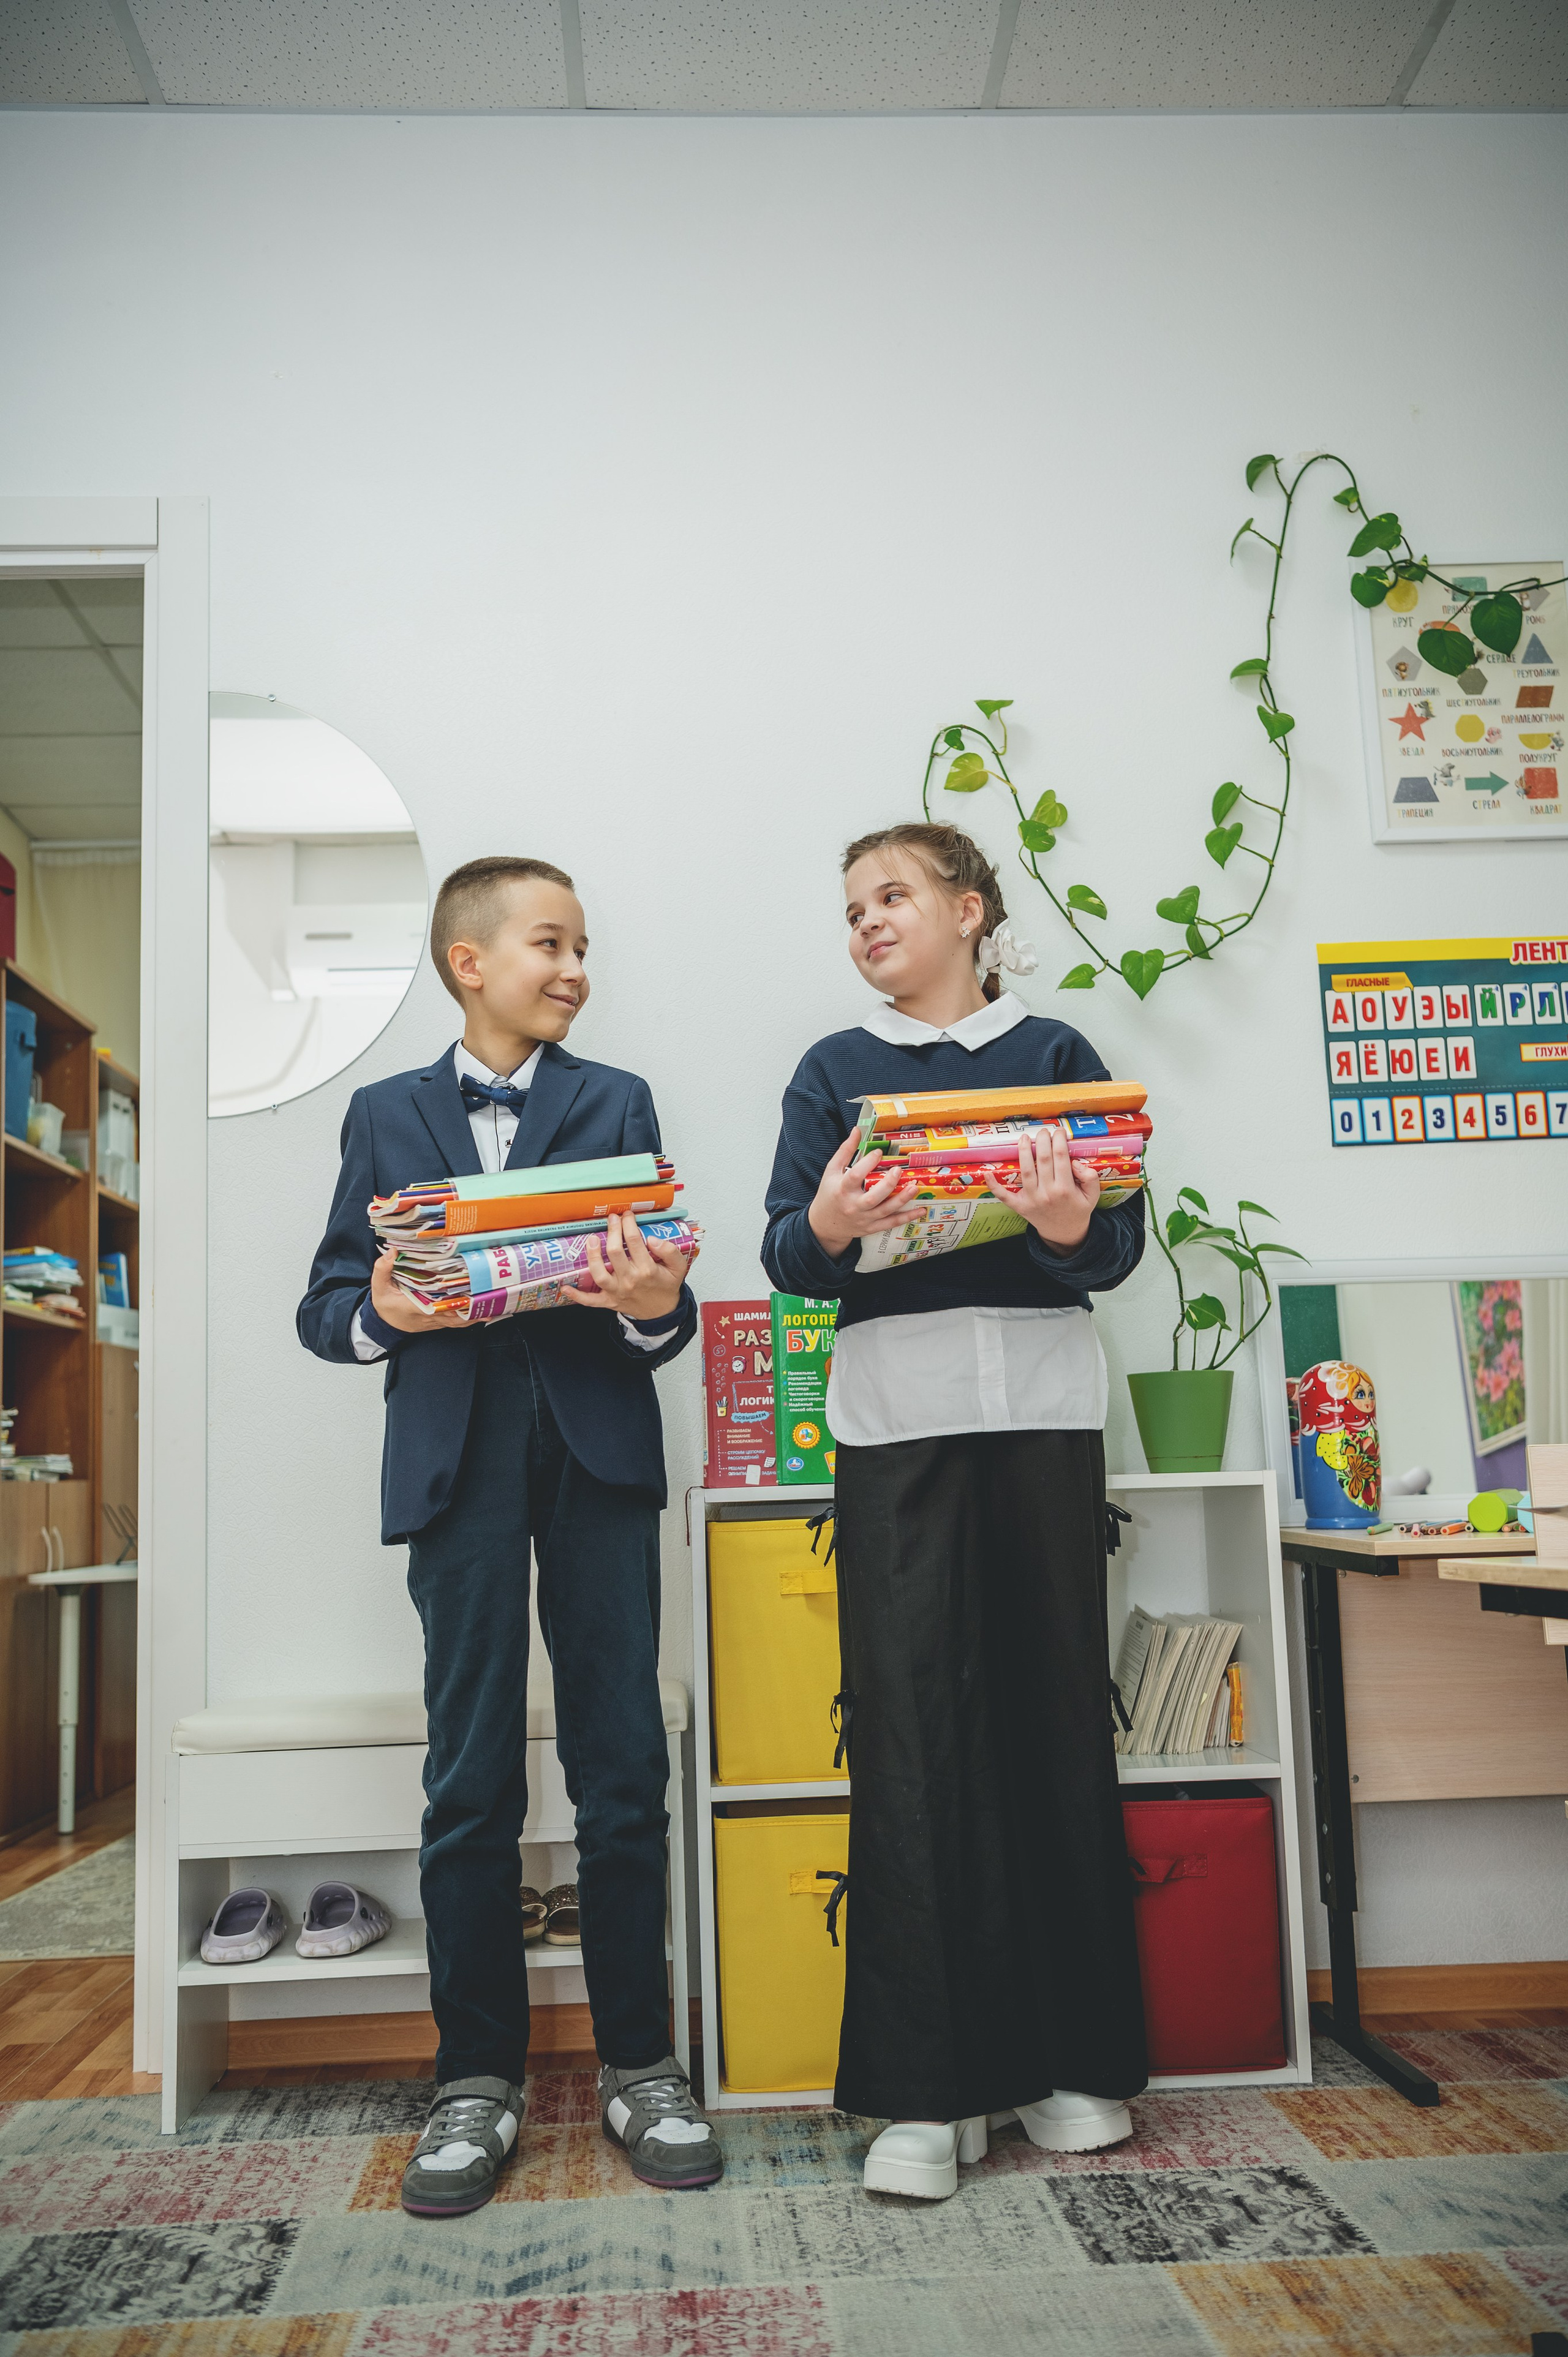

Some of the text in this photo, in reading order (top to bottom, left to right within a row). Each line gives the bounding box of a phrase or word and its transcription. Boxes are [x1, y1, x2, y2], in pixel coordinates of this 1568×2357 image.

[1392, 617, 1414, 628] КРУГ
[1526, 615, 1546, 625] РОМБ
[1513, 668, 1561, 678] ТРЕУГОЛЬНИК
[1382, 687, 1441, 698] ПЯТИУГОЛЬНИК
[1446, 698, 1501, 708] ШЕСТИУГОЛЬНИК
[1501, 714, 1564, 724] ПАРАЛЛЕЛОГРАММ
[1399, 747, 1425, 756] ЗВЕЗДА
[1442, 747, 1503, 758] ВОСЬМИУГОЛЬНИК
[1519, 753, 1557, 763] ПОЛУКРУГ
[1472, 799, 1500, 810] СТРЕЛА
[1530, 804, 1562, 815] КВАДРАТ
[1397, 808, 1434, 818] ТРАПЕЦИЯ
[1346, 977, 1390, 987] ГЛАСНЫЕ
[1535, 1046, 1568, 1057] ГЛУХИ
[1074, 1116, 1096, 1128] Т
